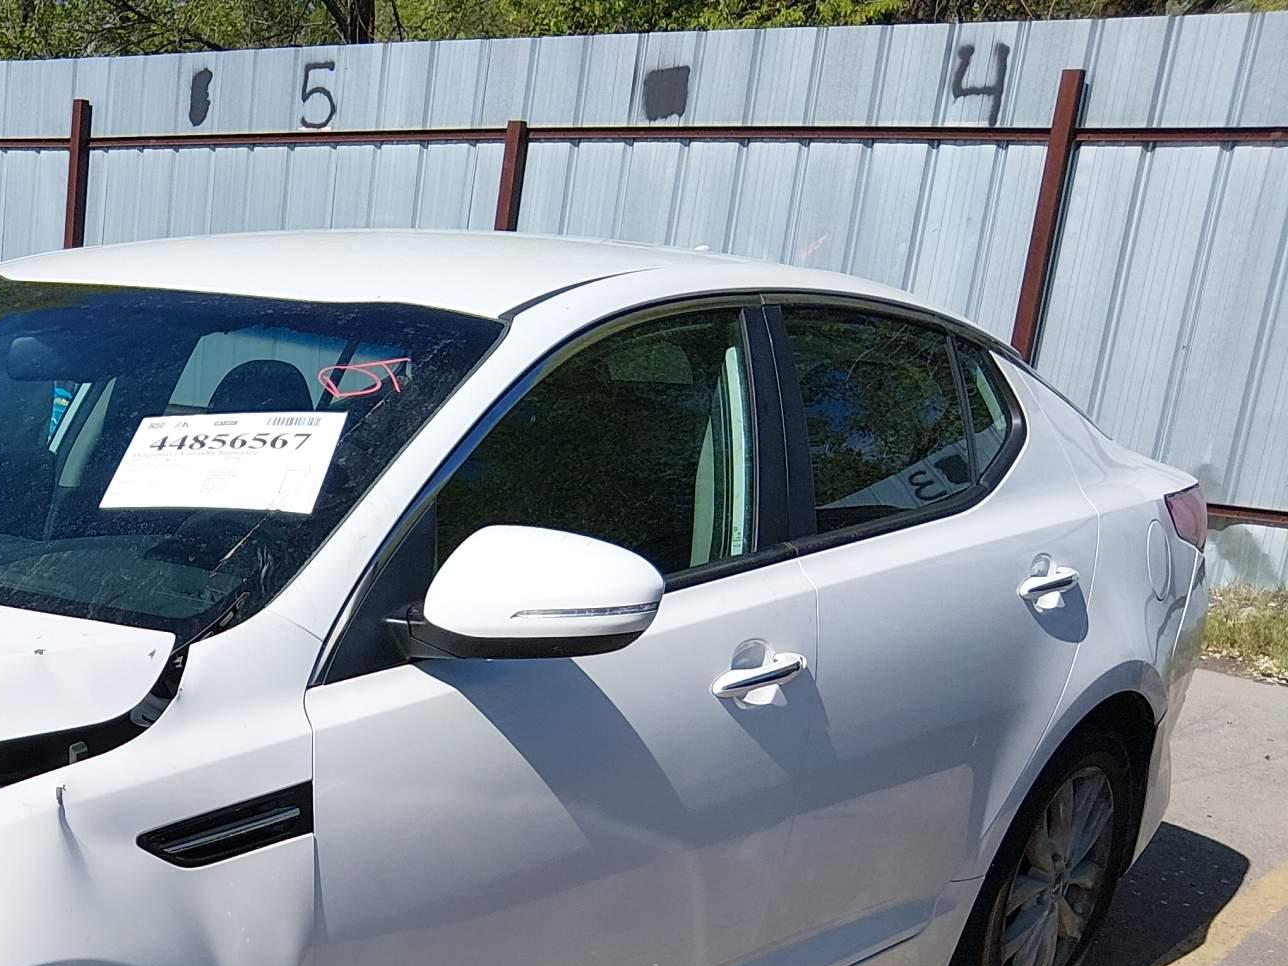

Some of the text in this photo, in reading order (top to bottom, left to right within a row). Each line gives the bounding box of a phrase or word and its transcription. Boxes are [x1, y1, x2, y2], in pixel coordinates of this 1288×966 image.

[301, 60, 336, 129] 5
[952, 42, 1010, 127] 4
[149, 432, 313, 451] 44856567
